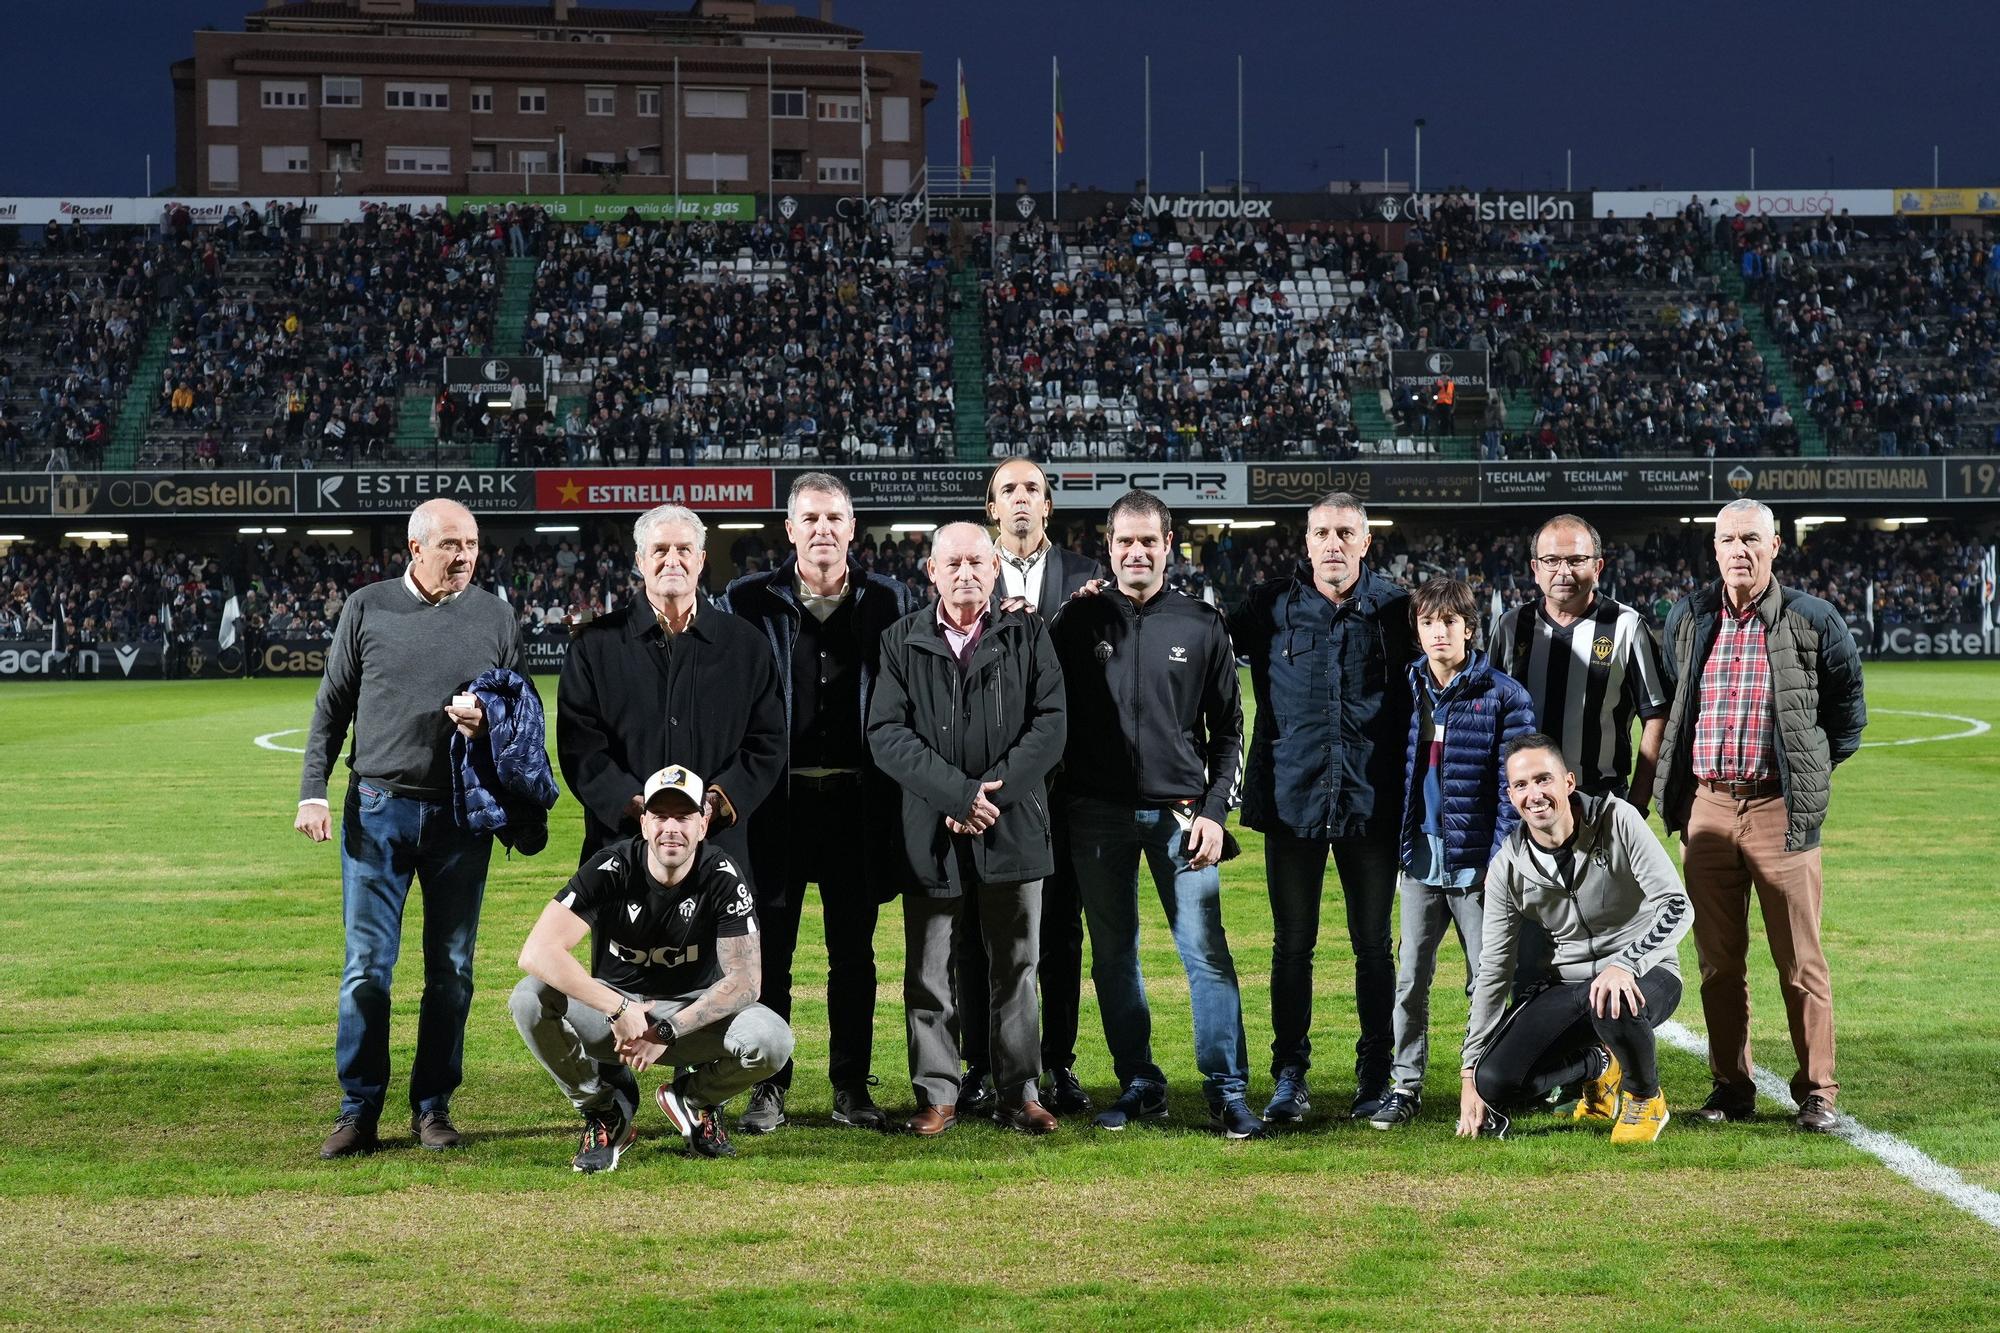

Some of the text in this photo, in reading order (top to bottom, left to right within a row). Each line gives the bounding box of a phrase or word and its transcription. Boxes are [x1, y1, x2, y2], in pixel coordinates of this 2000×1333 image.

[72, 204, 113, 215] Rosell
[594, 199, 740, 216] tu comañía de luz y gas
[1757, 191, 1834, 214] bausá
[356, 474, 517, 494] ESTEPARK
[849, 471, 983, 481] CENTRO DE NEGOCIOS
[1252, 467, 1371, 492] Bravoplaya
[1385, 476, 1474, 486] CAMPING RESORT
[1757, 464, 1928, 491] AFICIÓN CENTENARIA
[1959, 463, 2000, 494] 19
[0, 486, 49, 504] LUT
[588, 484, 753, 504] ESTRELLA DAMM
[870, 482, 914, 492] PUERTA
[940, 482, 963, 492] SOL
[358, 499, 418, 508] TU PUNTO
[0, 649, 100, 673] acrn
[608, 938, 699, 968] DIGI
